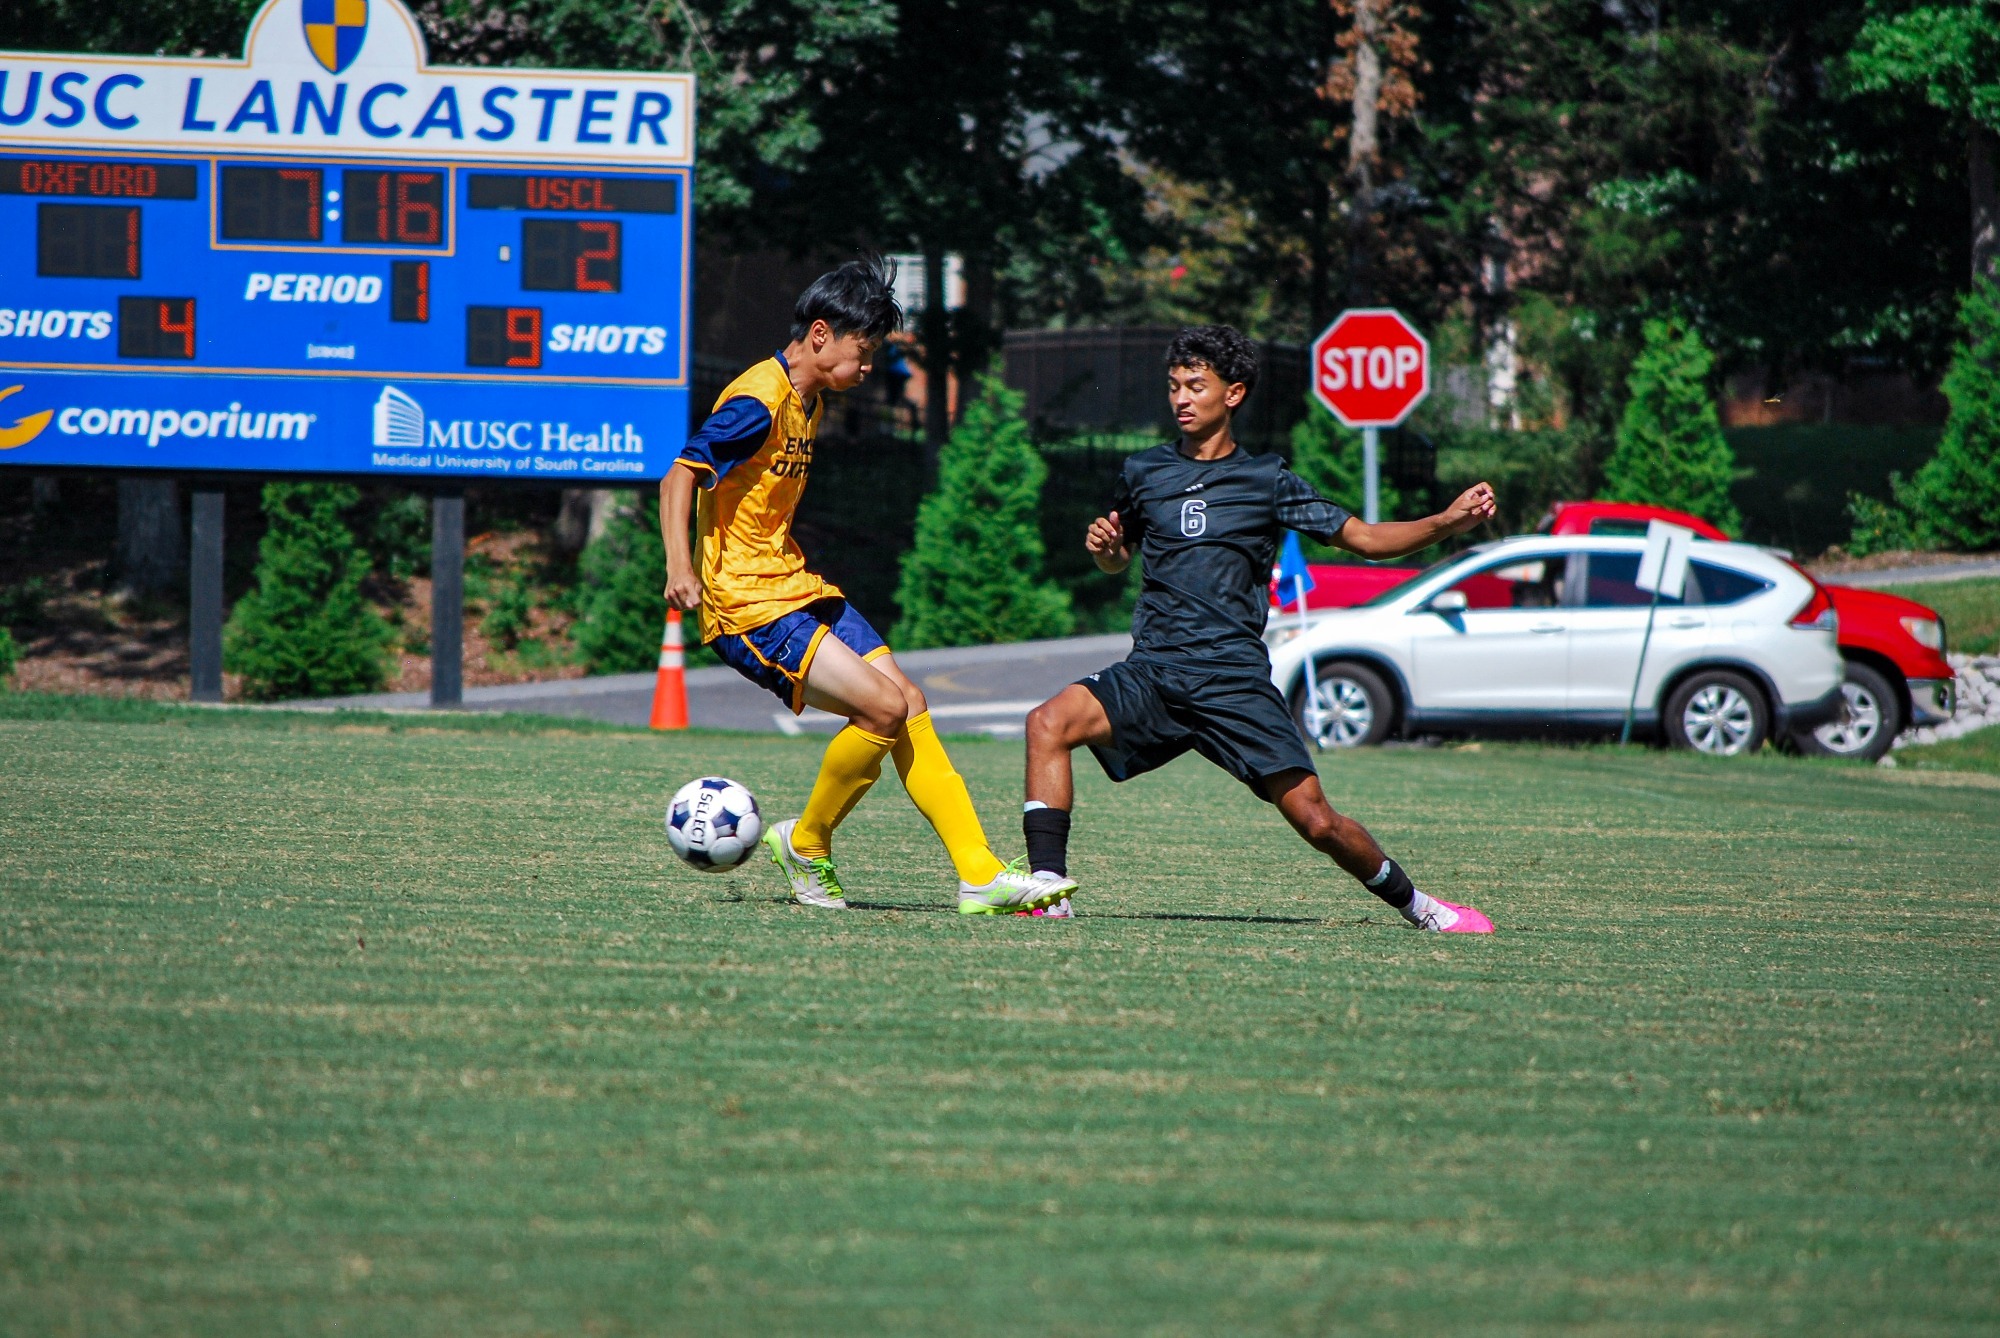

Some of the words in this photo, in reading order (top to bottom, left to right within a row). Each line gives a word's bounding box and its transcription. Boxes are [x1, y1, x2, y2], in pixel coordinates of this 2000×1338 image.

[0, 70, 144, 130] USC
[182, 78, 673, 145] LANCASTER
[20, 162, 157, 196] OXFORD
[526, 177, 615, 211] USCL
[126, 208, 138, 277] 1
[576, 221, 617, 291] 2
[245, 273, 382, 303] PERIOD
[417, 262, 429, 322] 1
[0, 308, 112, 339] SHOTS
[159, 300, 194, 357] 4
[506, 308, 541, 367] 9
[548, 325, 667, 354] SHOTS
[1322, 347, 1420, 390] STOP
[58, 402, 310, 447] comporium
[428, 420, 532, 450] MUSC
[541, 423, 643, 453] Health
[372, 453, 431, 468] Medical
[436, 454, 511, 472] University
[516, 456, 530, 470] of
[534, 457, 577, 471] South
[581, 458, 645, 473] Carolina
[1180, 500, 1207, 537] 6
[691, 793, 713, 846] SELECT
